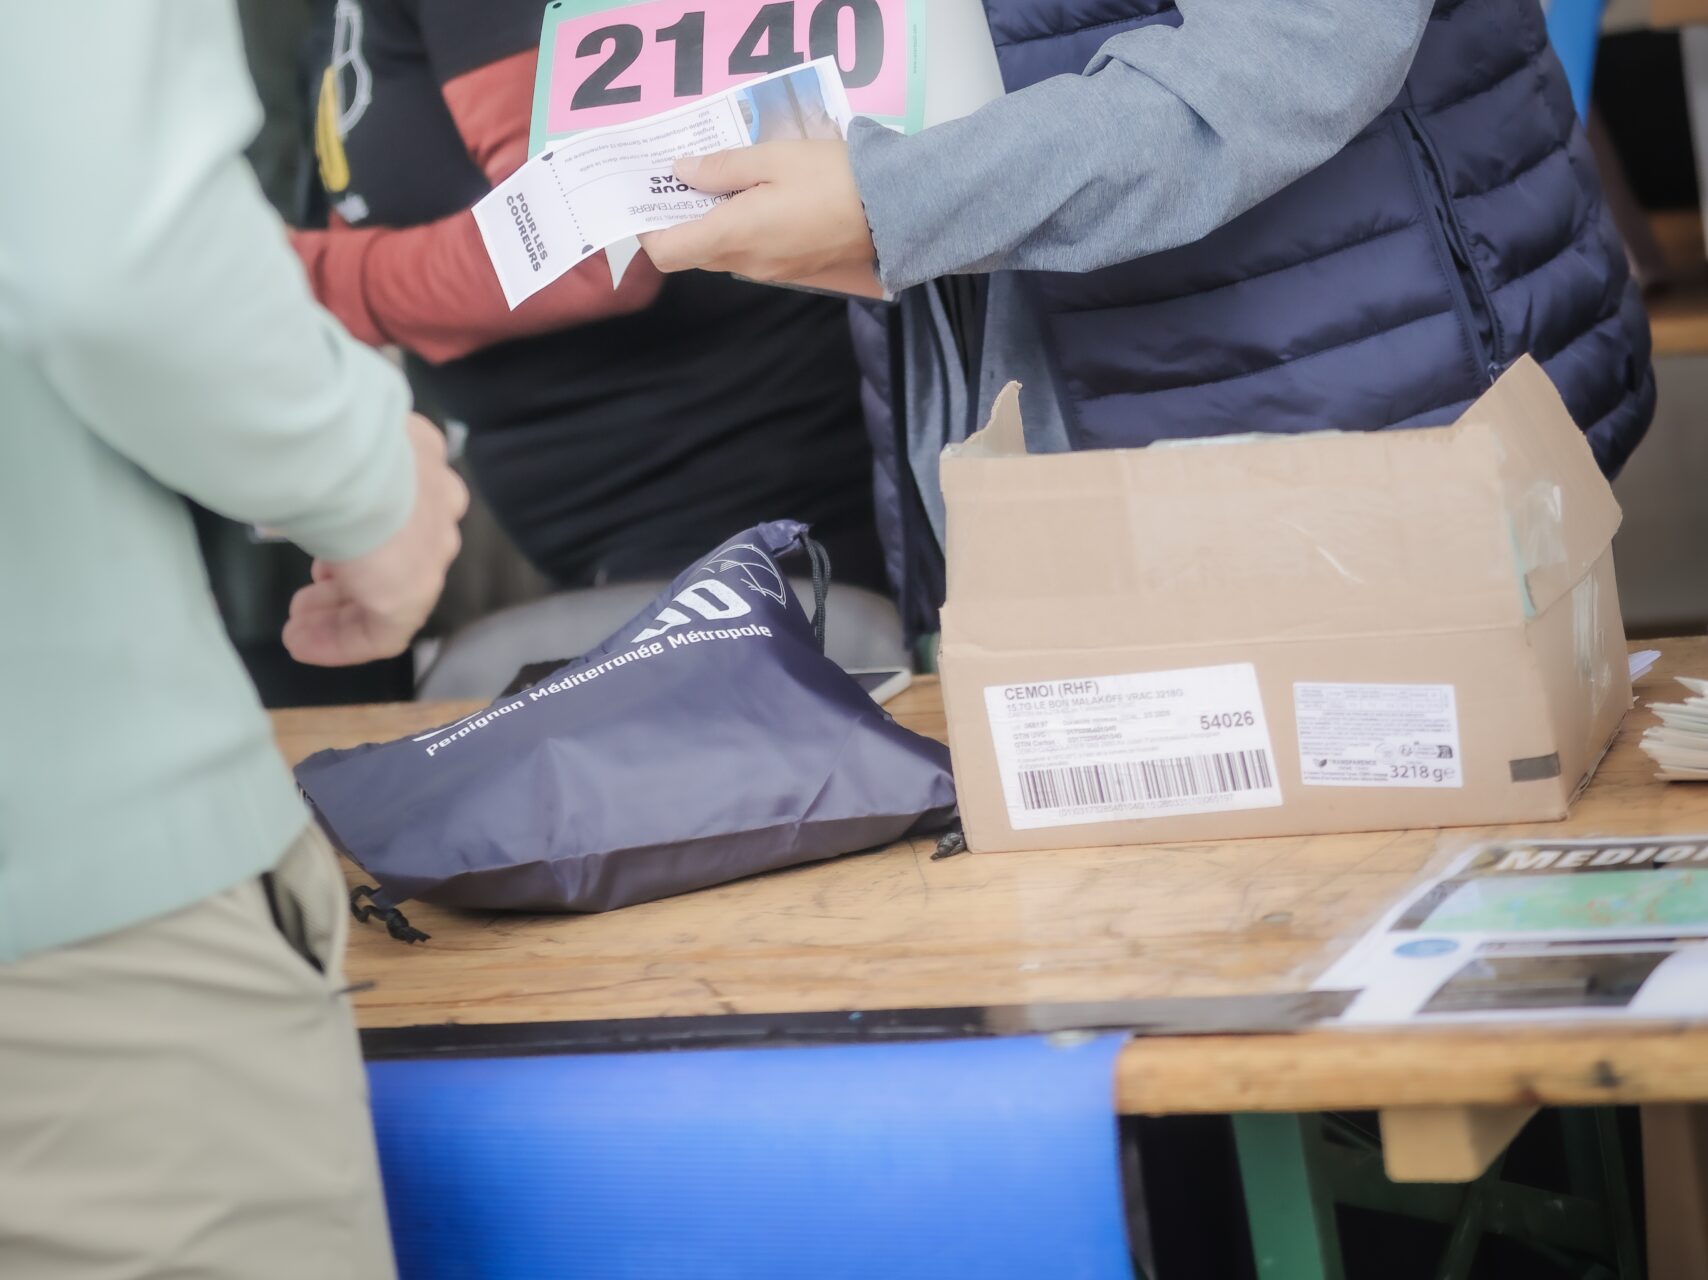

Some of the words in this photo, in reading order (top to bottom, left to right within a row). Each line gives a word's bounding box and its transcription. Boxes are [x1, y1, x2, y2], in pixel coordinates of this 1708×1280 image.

[650, 174, 681, 185] AS
[649, 183, 696, 194] OUR
[627, 200, 694, 215] SEPTEMBRE
[695, 199, 709, 208] 13
[506, 195, 542, 272] COUREURS
[516, 192, 537, 234] POUR
[533, 234, 548, 260] LES
[426, 700, 525, 757] Perpignan
[528, 642, 664, 701] Méditerranée
[667, 623, 773, 650] Métropole
[1004, 685, 1053, 701] CEMOI
[1058, 680, 1099, 697] (RHF)
[1049, 700, 1069, 709] BON
[1200, 711, 1255, 731] 54026
[1390, 765, 1429, 778] 3218
